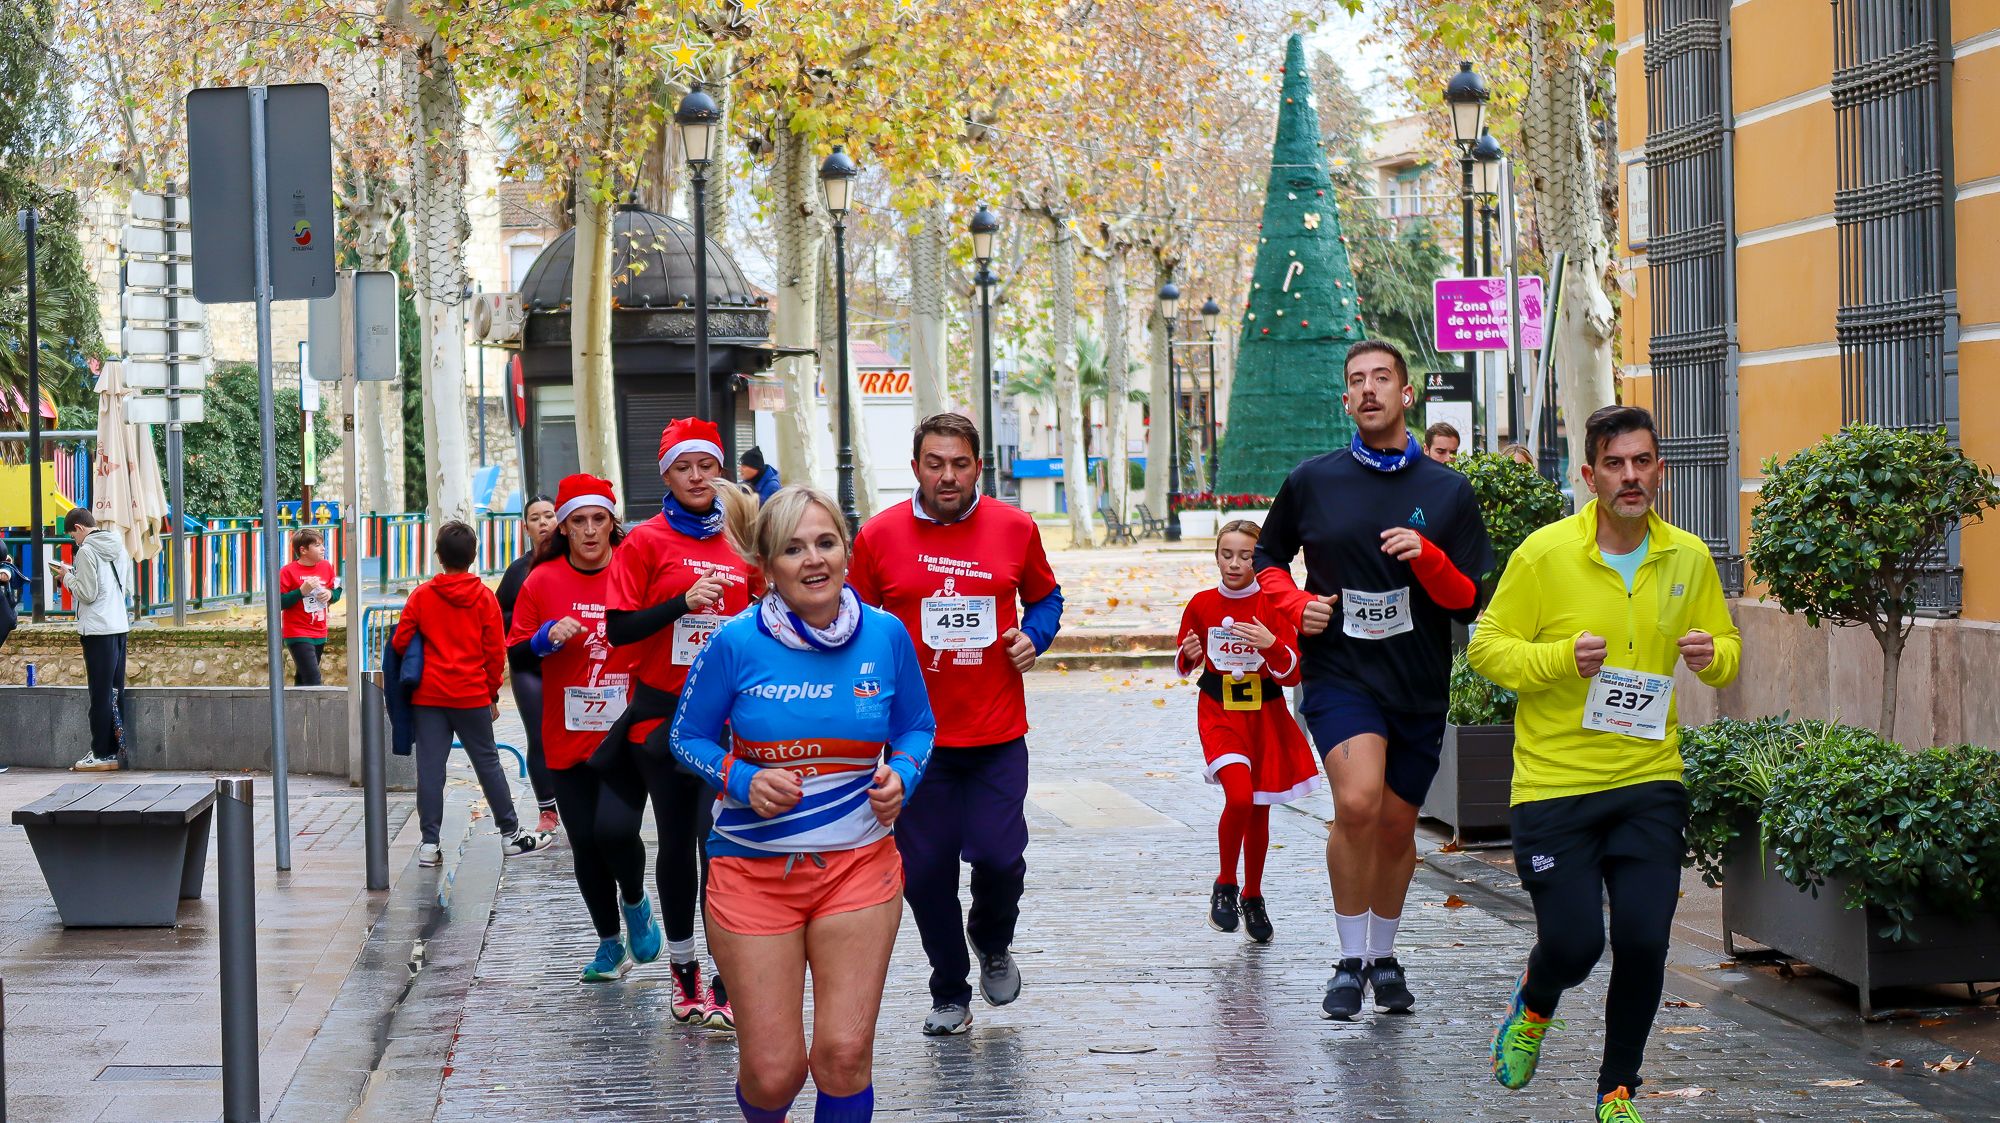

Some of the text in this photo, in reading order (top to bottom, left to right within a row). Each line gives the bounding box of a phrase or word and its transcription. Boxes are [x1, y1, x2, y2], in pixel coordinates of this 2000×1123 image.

[1454, 300, 1507, 312] Zona lib
[1448, 314, 1527, 326] de violena
[1455, 327, 1508, 341] de géne
[688, 559, 701, 567] San
[923, 555, 937, 563] San
[939, 557, 971, 568] Silvestre
[928, 564, 992, 579] Ciudad de Lucena
[1355, 605, 1398, 621] 458
[936, 613, 980, 628] 435
[687, 631, 712, 645] 49
[1219, 641, 1255, 655] 464
[583, 701, 607, 713] 77
[1605, 689, 1654, 711] 237
[1378, 971, 1396, 981] NIKE
